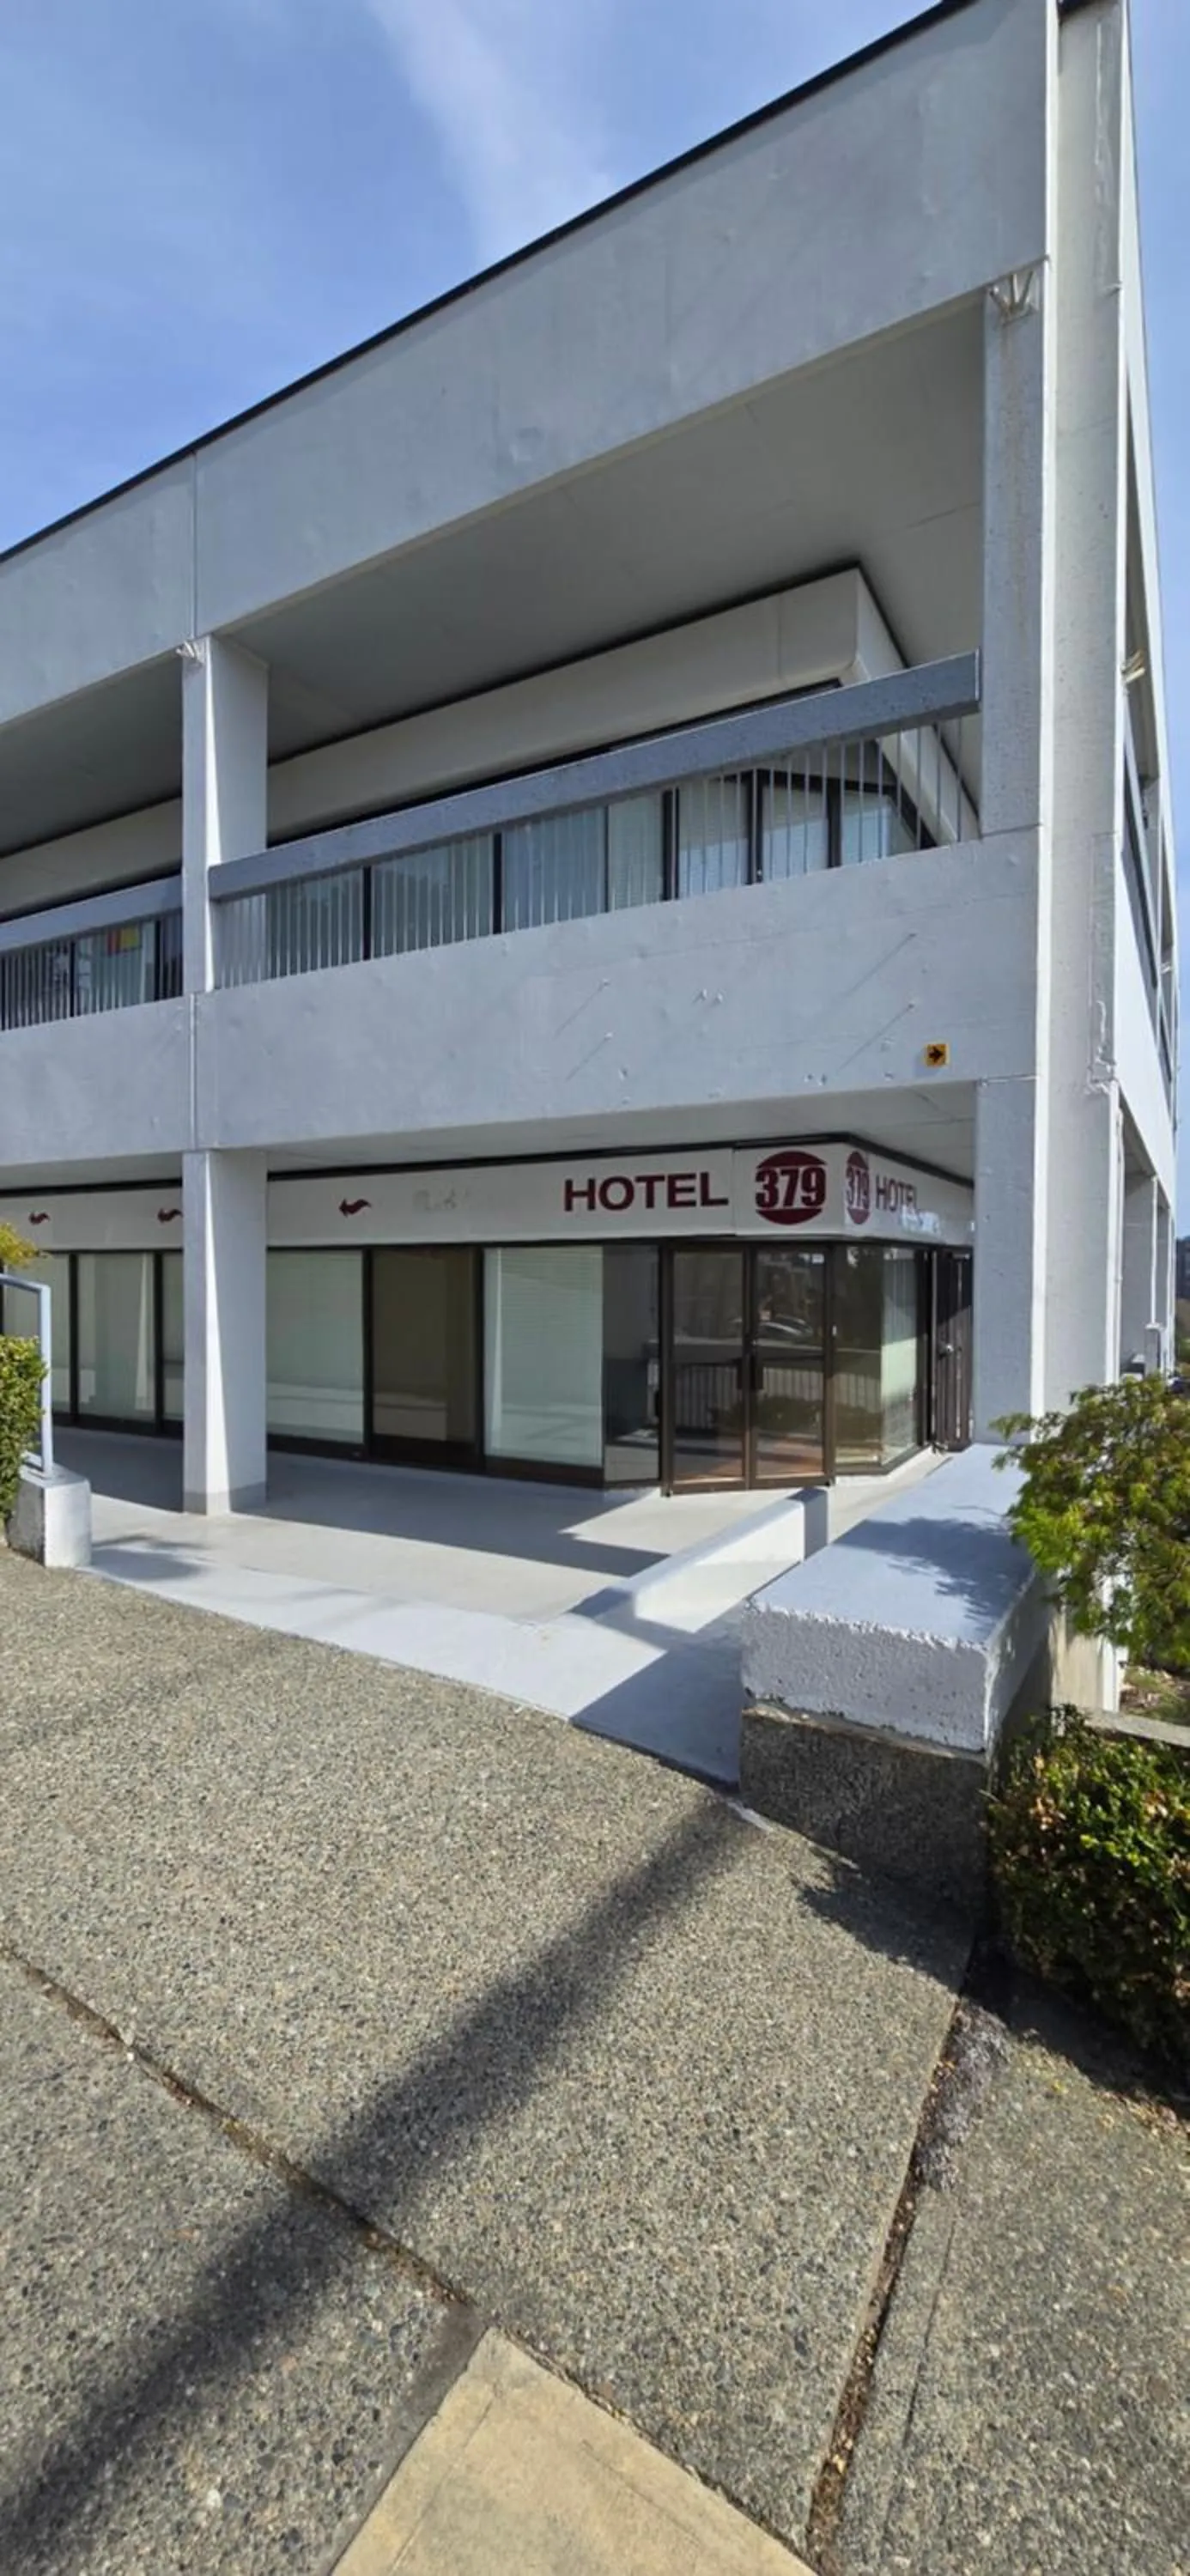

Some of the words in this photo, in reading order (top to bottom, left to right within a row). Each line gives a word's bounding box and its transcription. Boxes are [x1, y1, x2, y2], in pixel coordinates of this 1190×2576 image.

[564, 1171, 729, 1212] HOTEL
[755, 1167, 827, 1209] 379
[846, 1165, 870, 1209] 379
